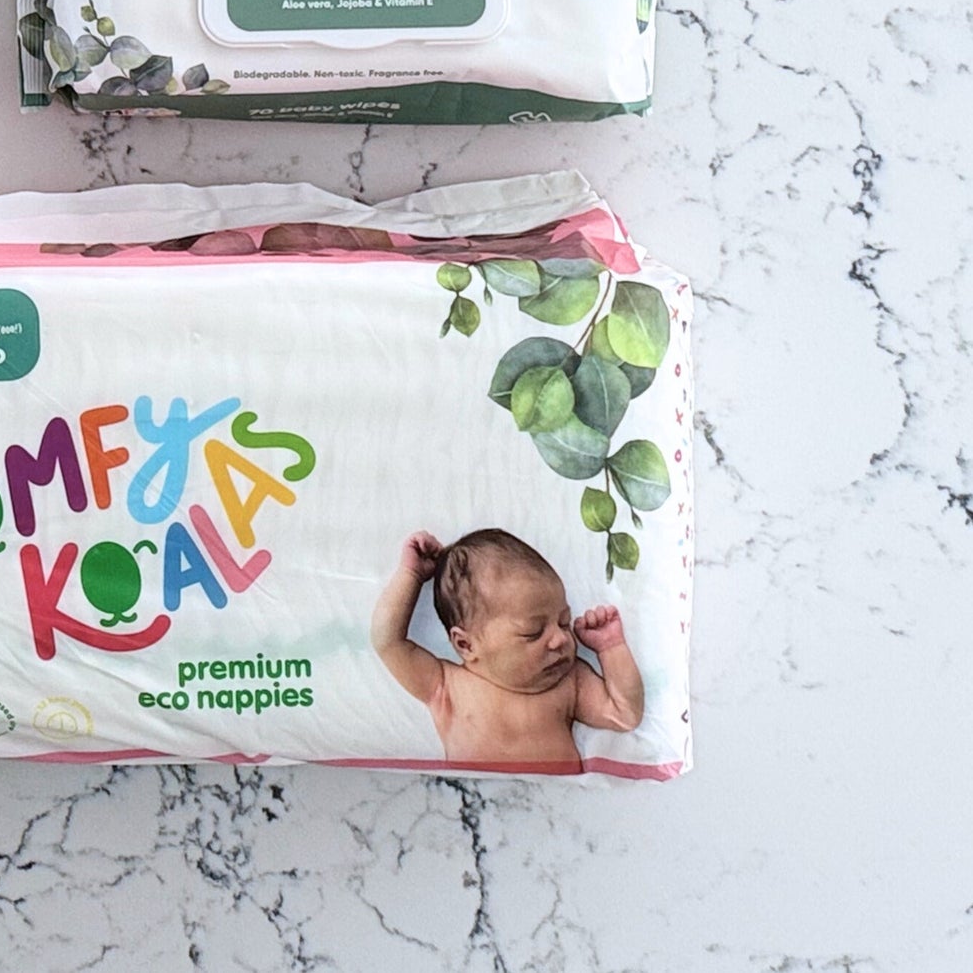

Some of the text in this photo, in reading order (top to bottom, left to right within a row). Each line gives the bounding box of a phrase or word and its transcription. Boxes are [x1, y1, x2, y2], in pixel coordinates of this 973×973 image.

[282, 0, 305, 9] Aloe
[307, 0, 333, 10] vera,
[233, 69, 311, 80] Biodegradable.
[314, 69, 366, 78] Non-toxic.
[369, 69, 421, 78] Fragrance
[19, 411, 317, 661] KOALAS
[178, 653, 313, 688] premium
[138, 682, 315, 715] eco nappies
